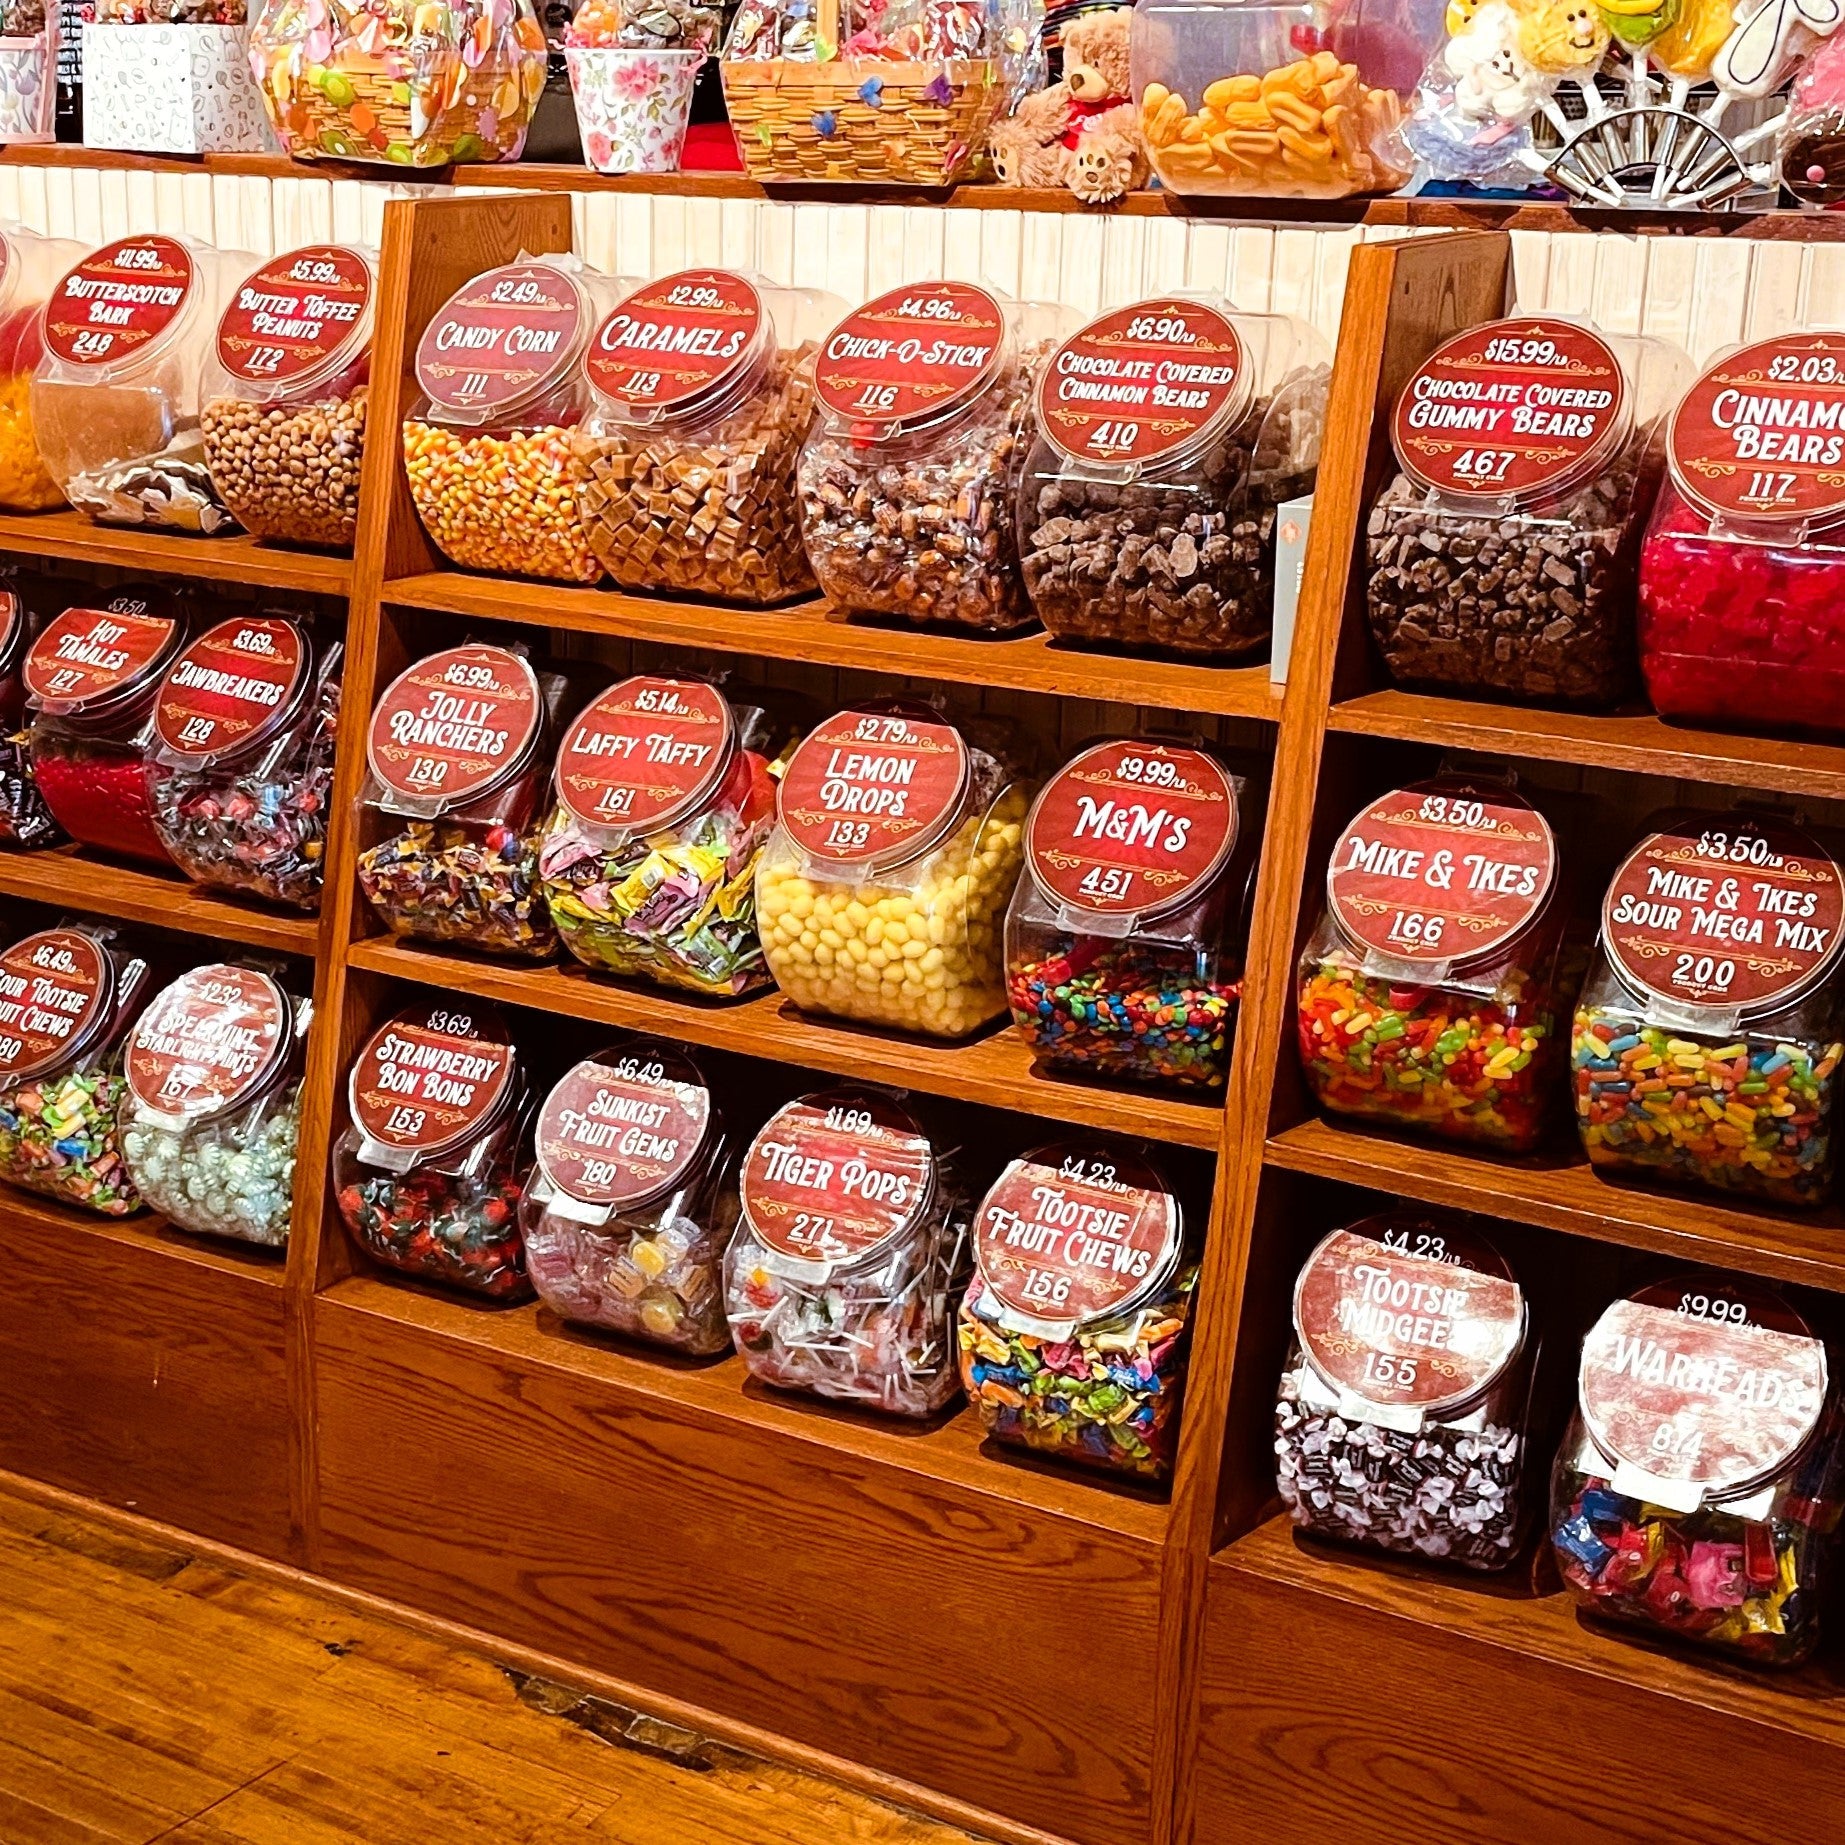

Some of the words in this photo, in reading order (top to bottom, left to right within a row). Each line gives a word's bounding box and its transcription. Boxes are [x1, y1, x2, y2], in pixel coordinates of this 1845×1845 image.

[66, 275, 183, 306] BUTTERSCOTCH
[239, 289, 300, 315] BUTTER
[303, 294, 362, 322] TOFFEE
[89, 301, 135, 325] BARK
[252, 312, 323, 339] PEANUTS
[436, 321, 506, 351] CANDY
[504, 325, 561, 356] CORN
[600, 315, 746, 358] CARAMELS
[828, 333, 990, 368] CHICK-O-STICK
[250, 347, 284, 368] 172
[1057, 350, 1156, 380] CHOCOLATE
[1156, 360, 1234, 386] COVERED
[461, 374, 489, 394] 111
[626, 371, 661, 393] 113
[859, 385, 899, 406] 116
[1058, 378, 1146, 404] CINNAMON
[1151, 386, 1211, 410] BEARS
[1413, 375, 1523, 404] CHOCOLATE
[1524, 382, 1613, 410] COVERED
[1090, 421, 1138, 446] 410
[1408, 400, 1506, 431] GUMMY
[1511, 410, 1597, 439] BEARS
[1453, 449, 1516, 475] 467
[1732, 424, 1844, 465] BEARS
[1748, 472, 1797, 499] 117
[86, 618, 128, 644] HOT
[54, 634, 130, 671] TAMALES
[49, 669, 85, 688] 127
[170, 660, 286, 707] JAWBREAKERS
[420, 691, 498, 727] JOLLY
[182, 716, 215, 740] 128
[389, 709, 510, 756] RANCHERS
[571, 727, 641, 759] LAFFY
[644, 733, 713, 768] TAFFY
[411, 757, 449, 782] 130
[825, 748, 917, 784] LEMON
[600, 787, 636, 811] 161
[820, 780, 909, 817] DROPS
[828, 820, 870, 845] 133
[1072, 796, 1192, 853] M&M'S
[1081, 866, 1133, 895] 451
[1348, 836, 1419, 880] MIKE
[1423, 849, 1455, 889] &
[1460, 853, 1539, 897] IKES
[1646, 866, 1710, 901] MIKE
[1714, 878, 1740, 910] &
[1751, 881, 1818, 917] IKES
[1391, 911, 1445, 942] 166
[1612, 895, 1681, 930] SOUR
[1689, 907, 1764, 944] MEGA
[1774, 919, 1831, 954] MIX
[1672, 953, 1735, 987] 200
[30, 977, 89, 1014] TOOTSIE
[20, 1005, 74, 1038] CHEWS
[376, 1034, 500, 1083] STRAWBERRY
[378, 1062, 419, 1096] BON
[423, 1071, 476, 1107] BONS
[389, 1106, 426, 1131] 153
[588, 1089, 671, 1128] SUNKIST
[559, 1110, 621, 1146] FRUIT
[619, 1127, 679, 1163] GEMS
[582, 1160, 617, 1185] 180
[760, 1141, 839, 1190] TIGER
[840, 1160, 911, 1205] POPS
[1031, 1187, 1130, 1241] TOOTSIE
[987, 1207, 1065, 1254] FRUIT
[1063, 1230, 1153, 1277] CHEWS
[1022, 1268, 1071, 1302] 156
[1353, 1265, 1469, 1317] TOOTSIE
[1340, 1298, 1458, 1349] MIDGEE
[1364, 1352, 1418, 1385] 155
